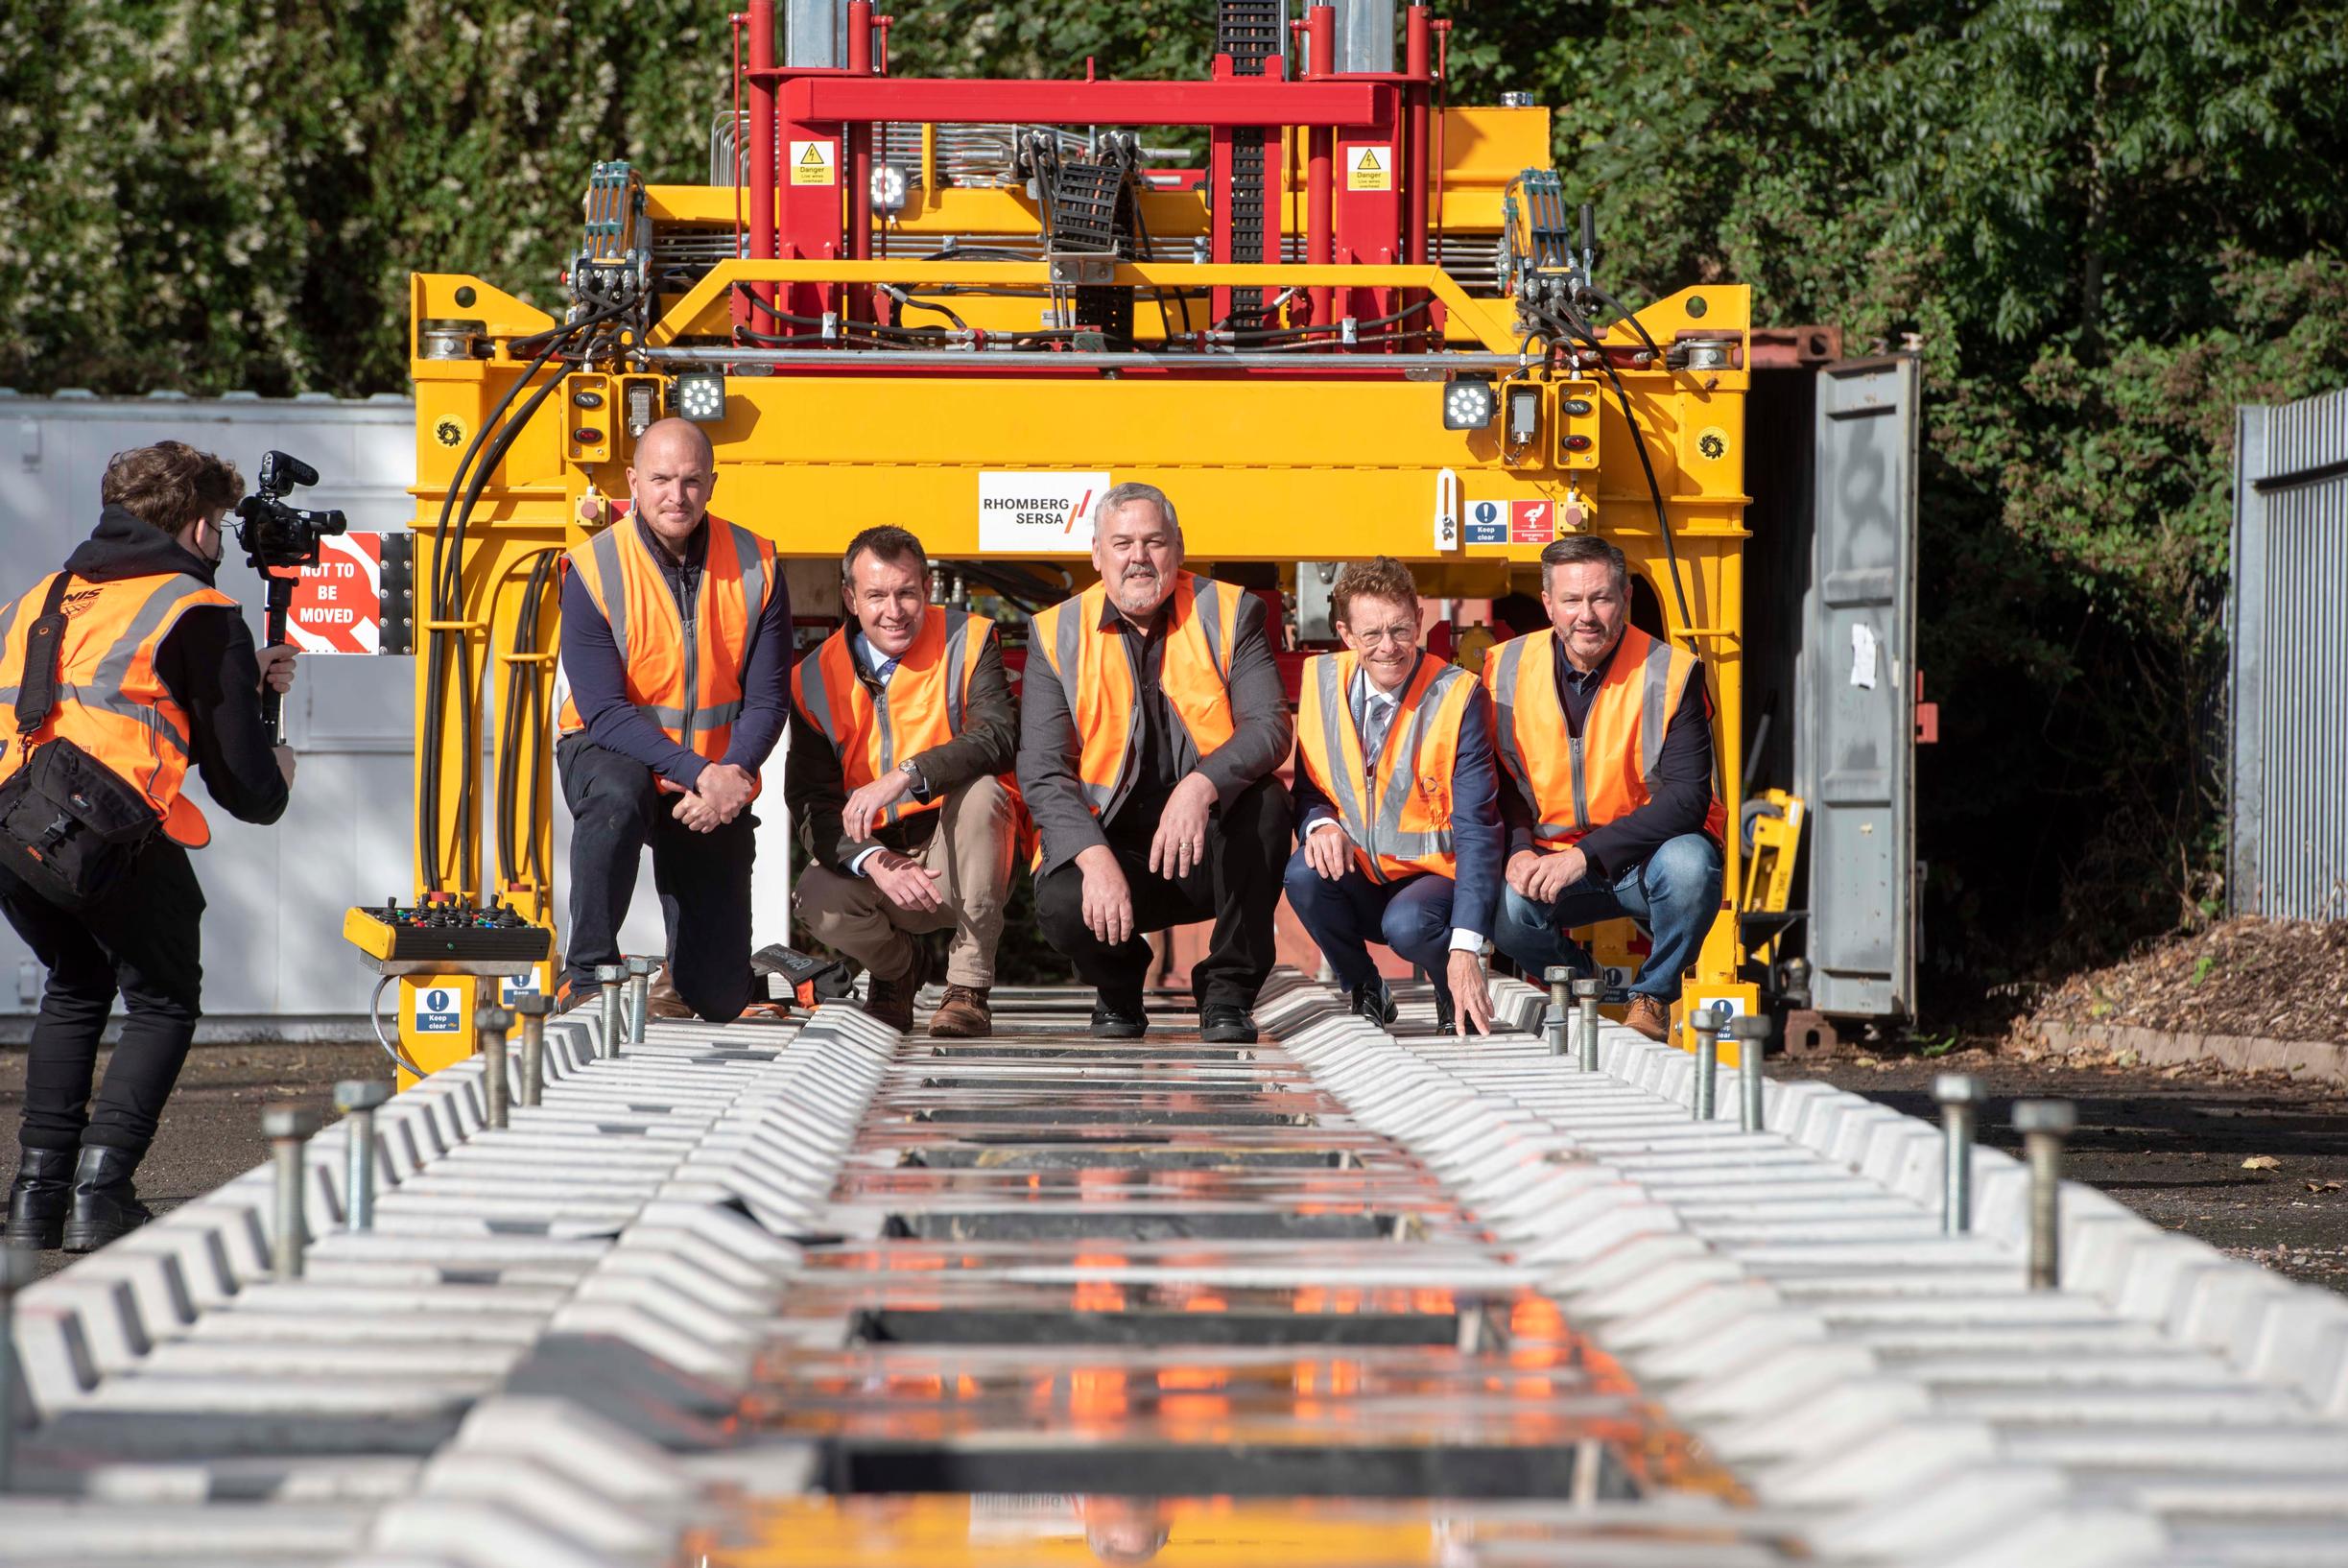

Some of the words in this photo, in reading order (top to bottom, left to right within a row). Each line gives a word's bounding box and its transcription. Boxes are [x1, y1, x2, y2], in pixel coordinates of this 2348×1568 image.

[984, 498, 1069, 510] RHOMBERG
[1016, 512, 1063, 524] SERSA
[300, 562, 330, 578] NOT
[335, 562, 355, 578] TO
[318, 585, 338, 600] BE
[299, 607, 353, 623] MOVED
